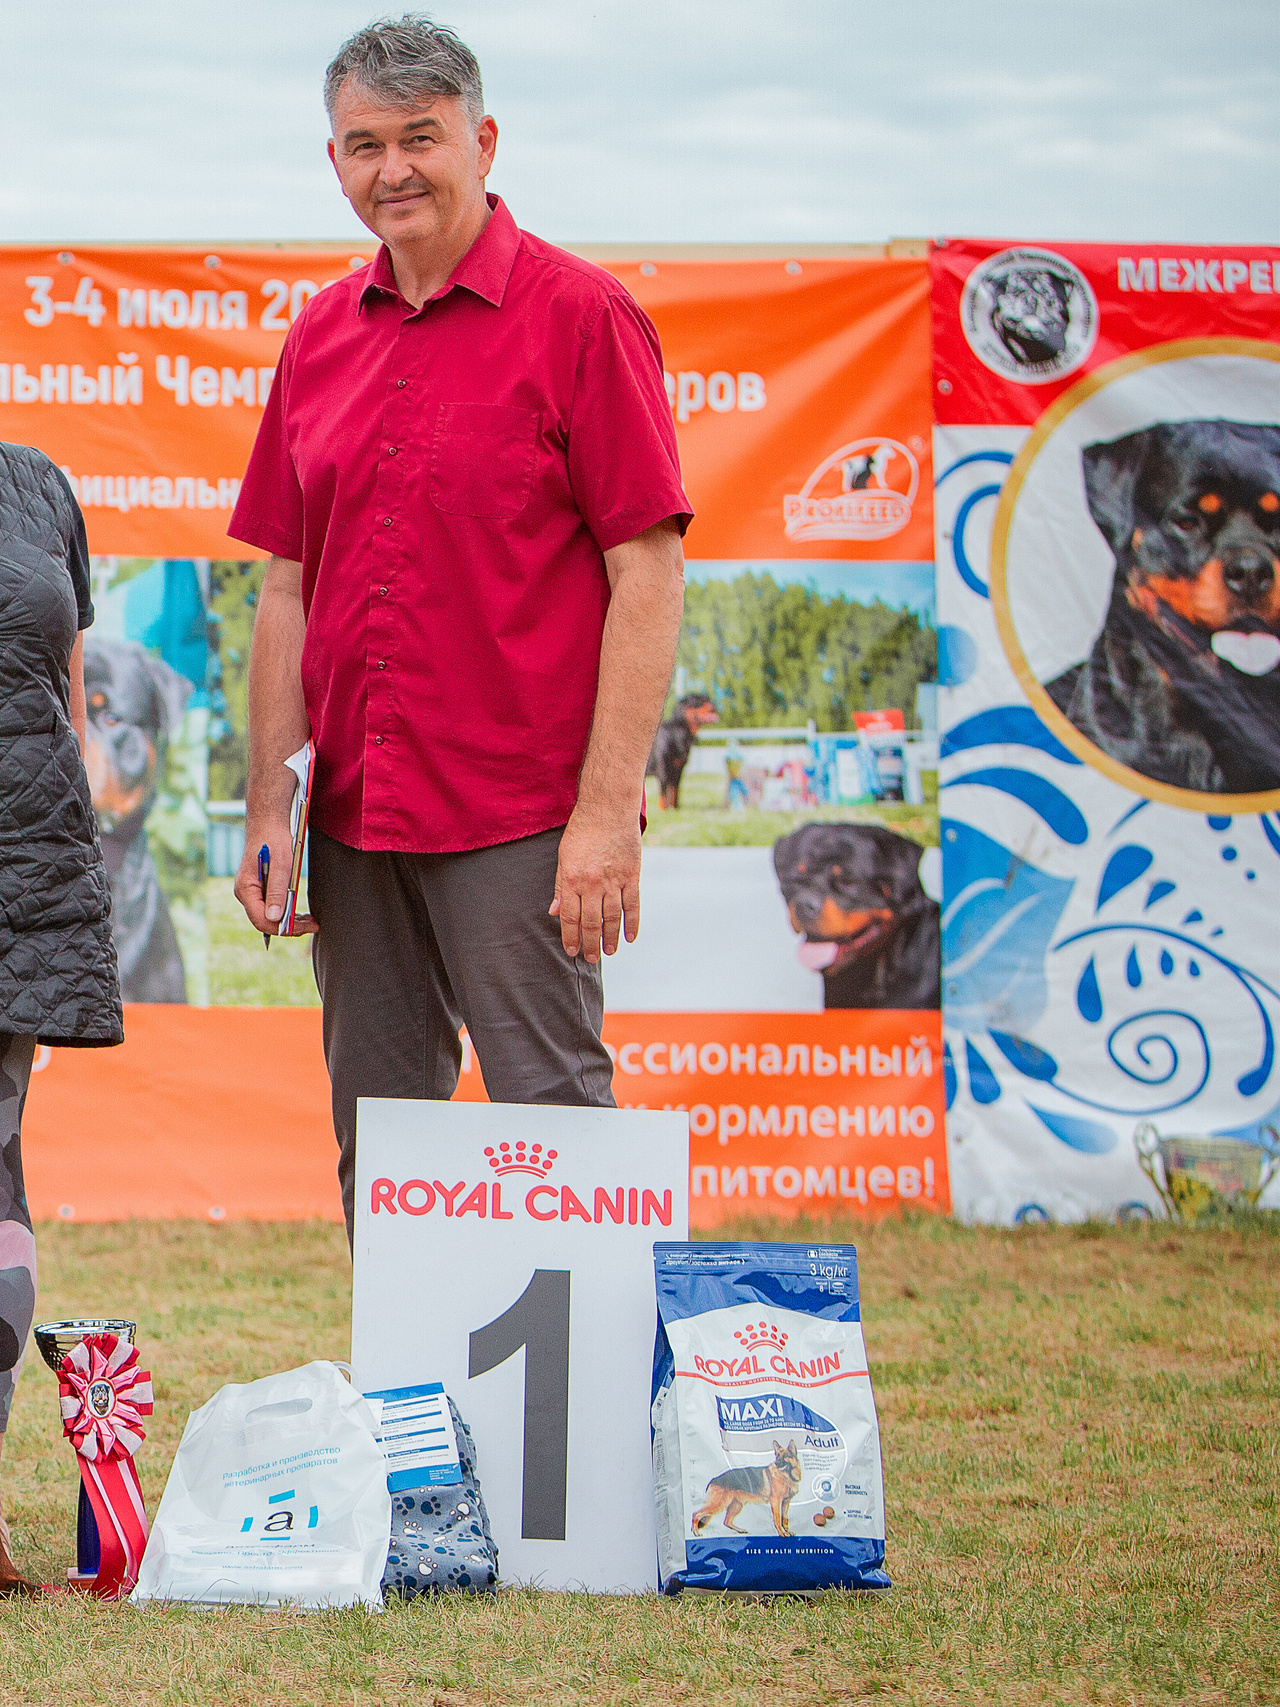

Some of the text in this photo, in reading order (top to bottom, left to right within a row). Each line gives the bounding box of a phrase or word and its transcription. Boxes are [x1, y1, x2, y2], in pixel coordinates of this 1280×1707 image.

[24, 275, 339, 331] 3-4 июля 20
[663, 1103, 935, 1146] ормлению
[690, 1156, 935, 1206] питомцев!
[371, 1178, 672, 1227] ROYAL CANIN
[809, 1263, 817, 1276] 3
[694, 1351, 841, 1379] ROYAL CANIN
[468, 1268, 571, 1541] 1
[720, 1398, 784, 1422] MAXI
[805, 1435, 839, 1448] Adult
[222, 1461, 270, 1480] Разработка
[279, 1447, 341, 1465] производство
[224, 1457, 338, 1488] ветеринарных препаратов
